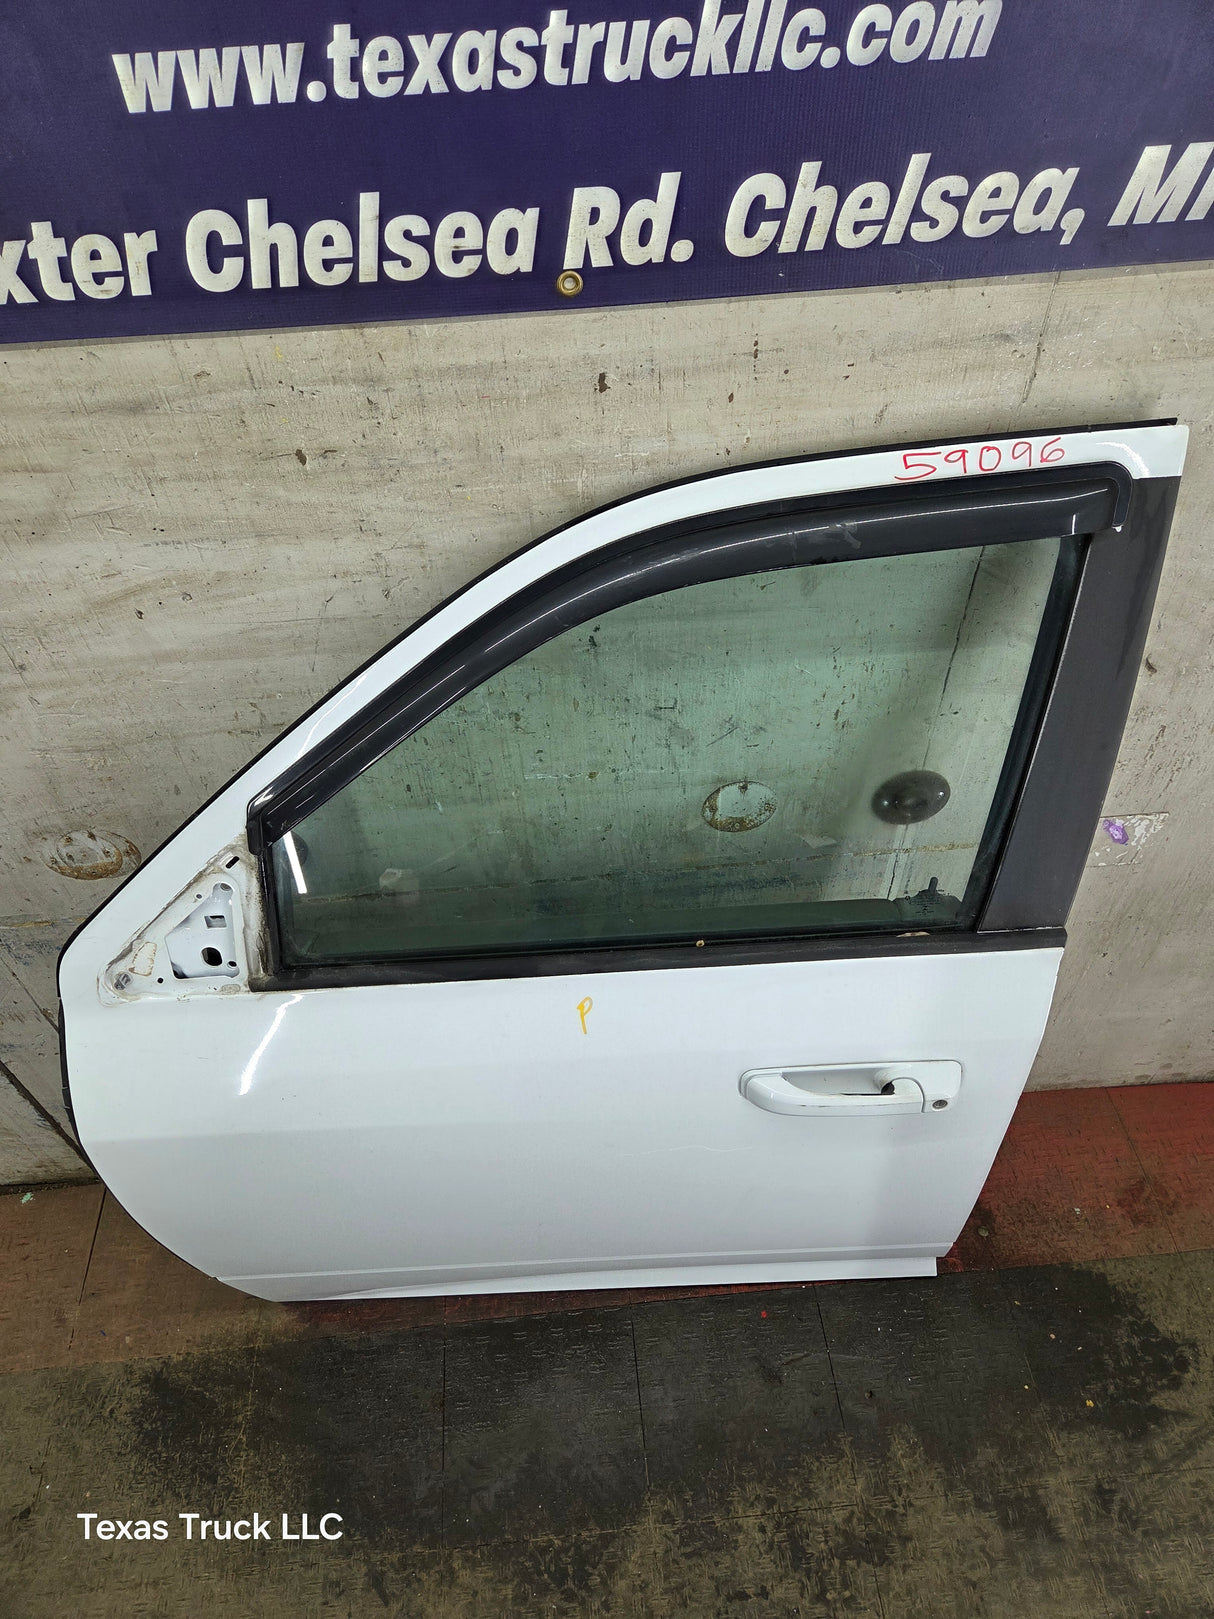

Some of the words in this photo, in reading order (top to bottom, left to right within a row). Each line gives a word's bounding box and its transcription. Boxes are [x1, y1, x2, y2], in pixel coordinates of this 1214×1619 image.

[111, 0, 1003, 114] www.texastruckllc.com
[0, 221, 158, 305] xter
[185, 191, 540, 293] Chelsea
[563, 171, 694, 270] Rd.
[724, 152, 1086, 258] Chelsea,
[894, 437, 1066, 480] 59096
